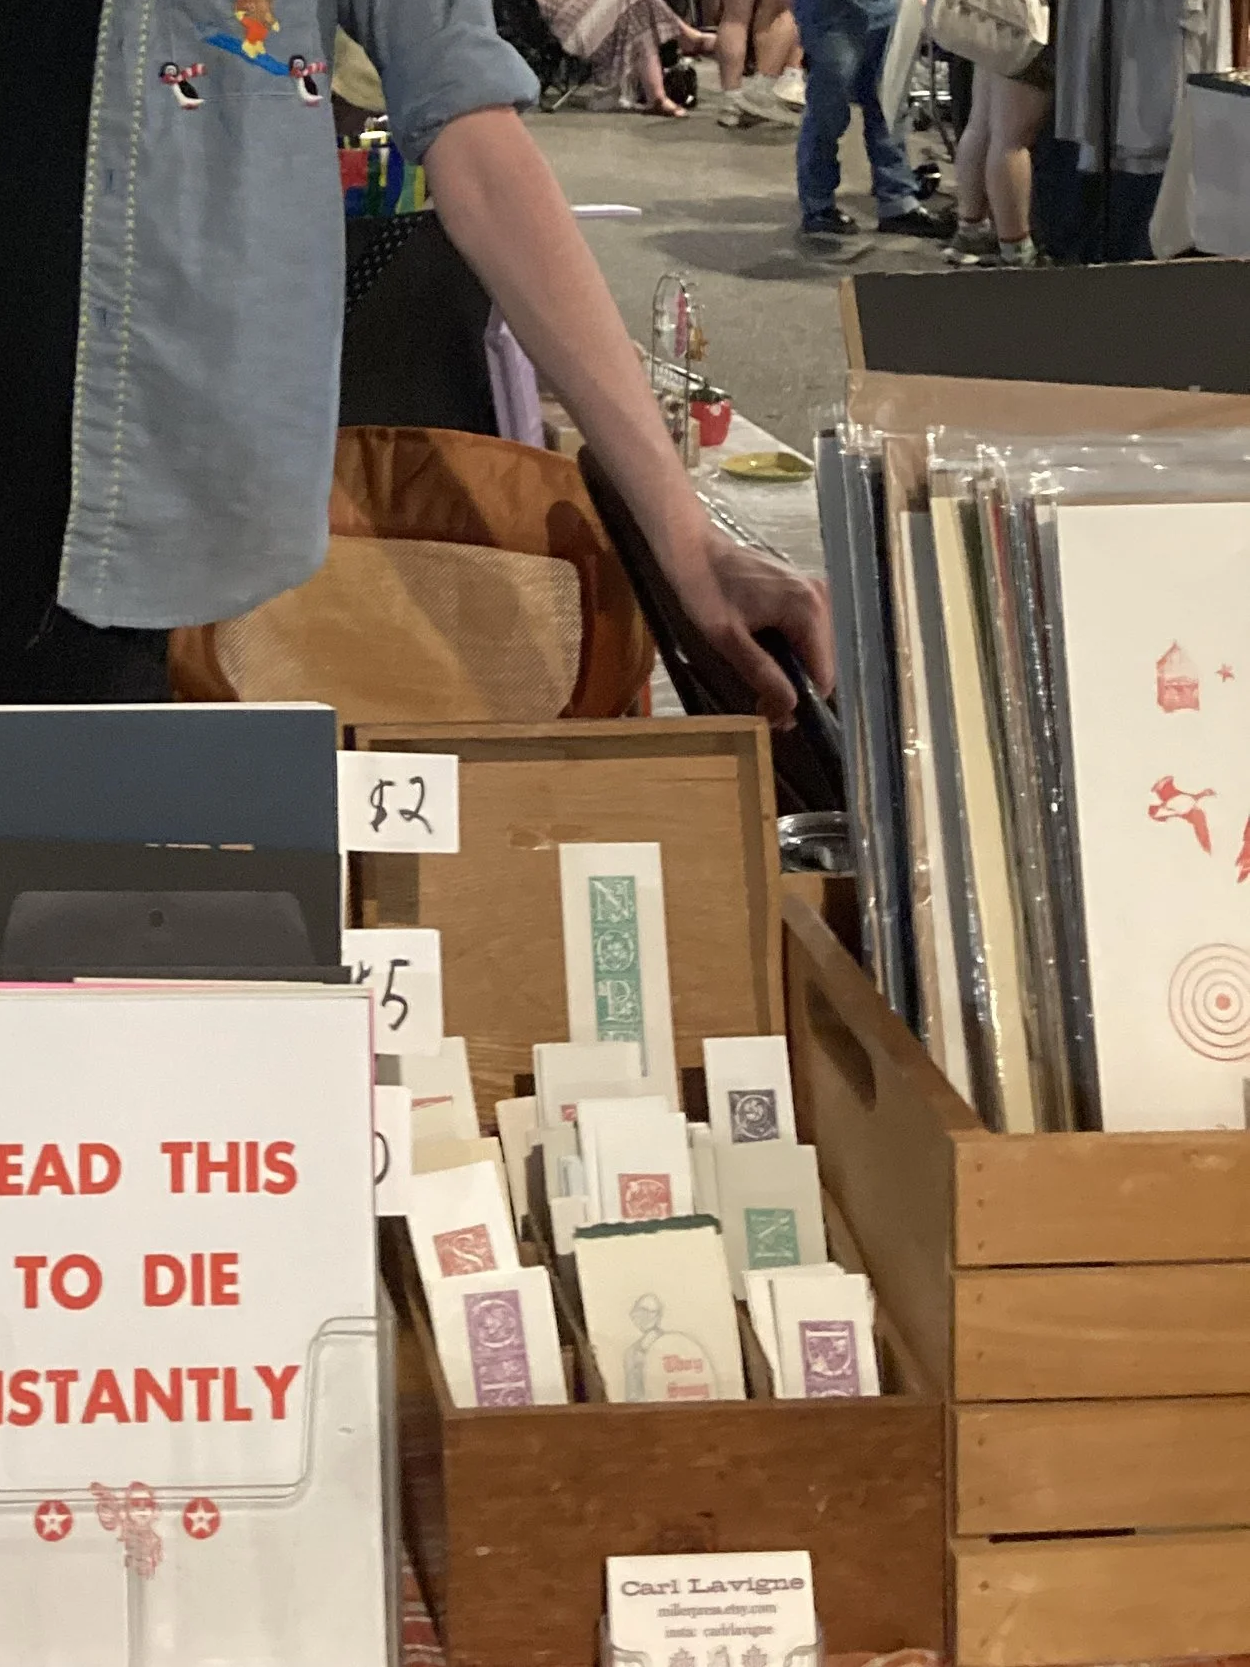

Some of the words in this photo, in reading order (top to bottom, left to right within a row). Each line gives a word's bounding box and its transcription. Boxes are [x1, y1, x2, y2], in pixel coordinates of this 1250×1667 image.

[370, 775, 434, 834] $2
[160, 1140, 299, 1195] THIS
[14, 1254, 103, 1310] TO
[143, 1252, 241, 1307] DIE
[621, 1579, 680, 1597] Carl
[688, 1577, 805, 1595] Lavigne
